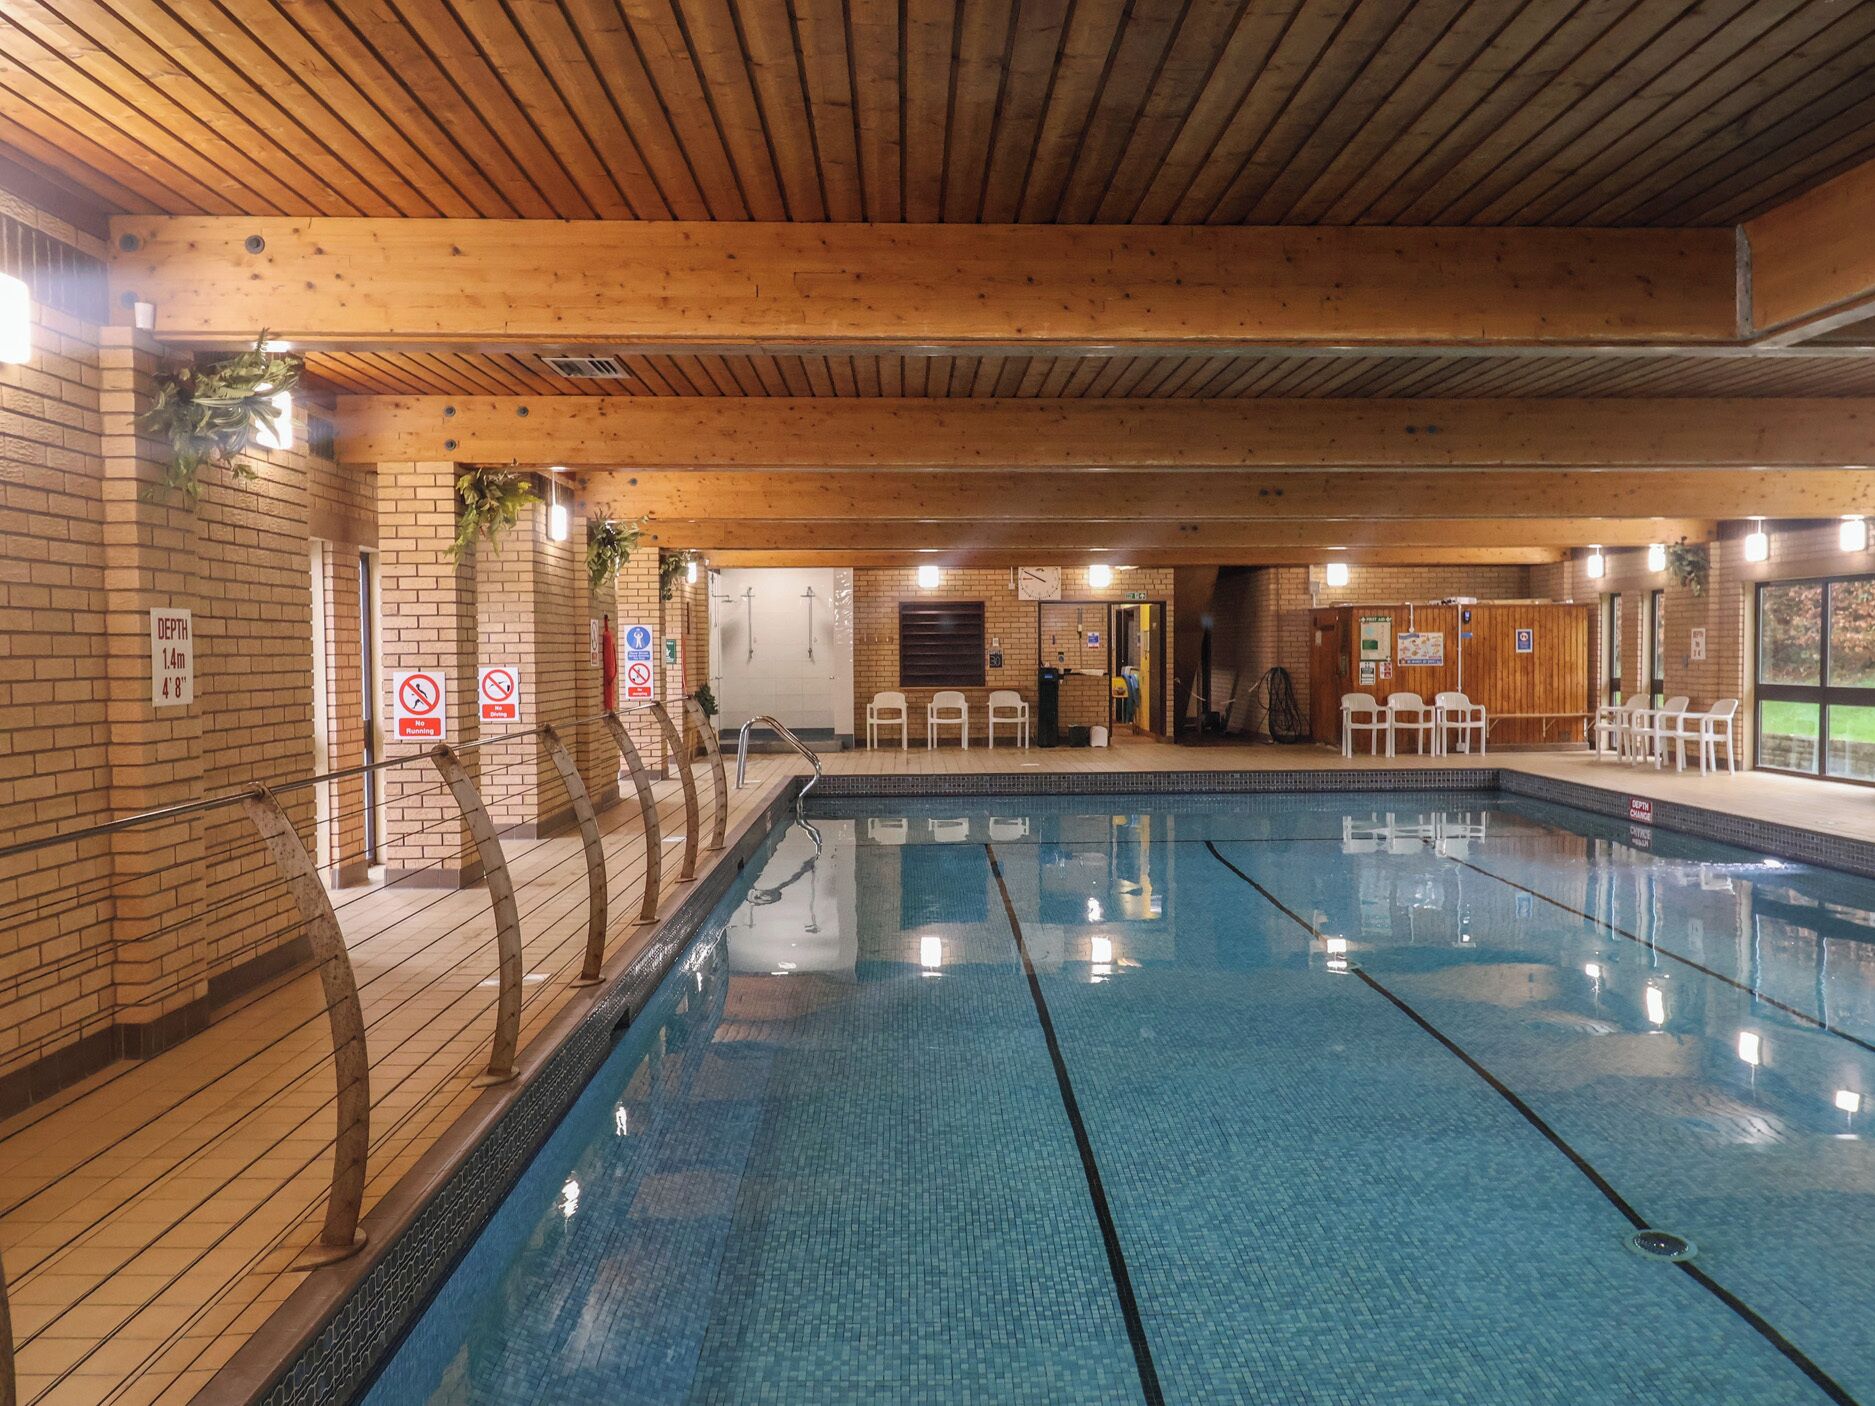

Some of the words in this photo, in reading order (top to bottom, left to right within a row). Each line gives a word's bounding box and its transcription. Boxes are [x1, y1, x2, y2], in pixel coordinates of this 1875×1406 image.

[157, 617, 188, 640] DEPTH
[162, 647, 185, 670] 1.4m
[1631, 800, 1649, 811] DEPTH
[1630, 809, 1651, 821] CHANGE
